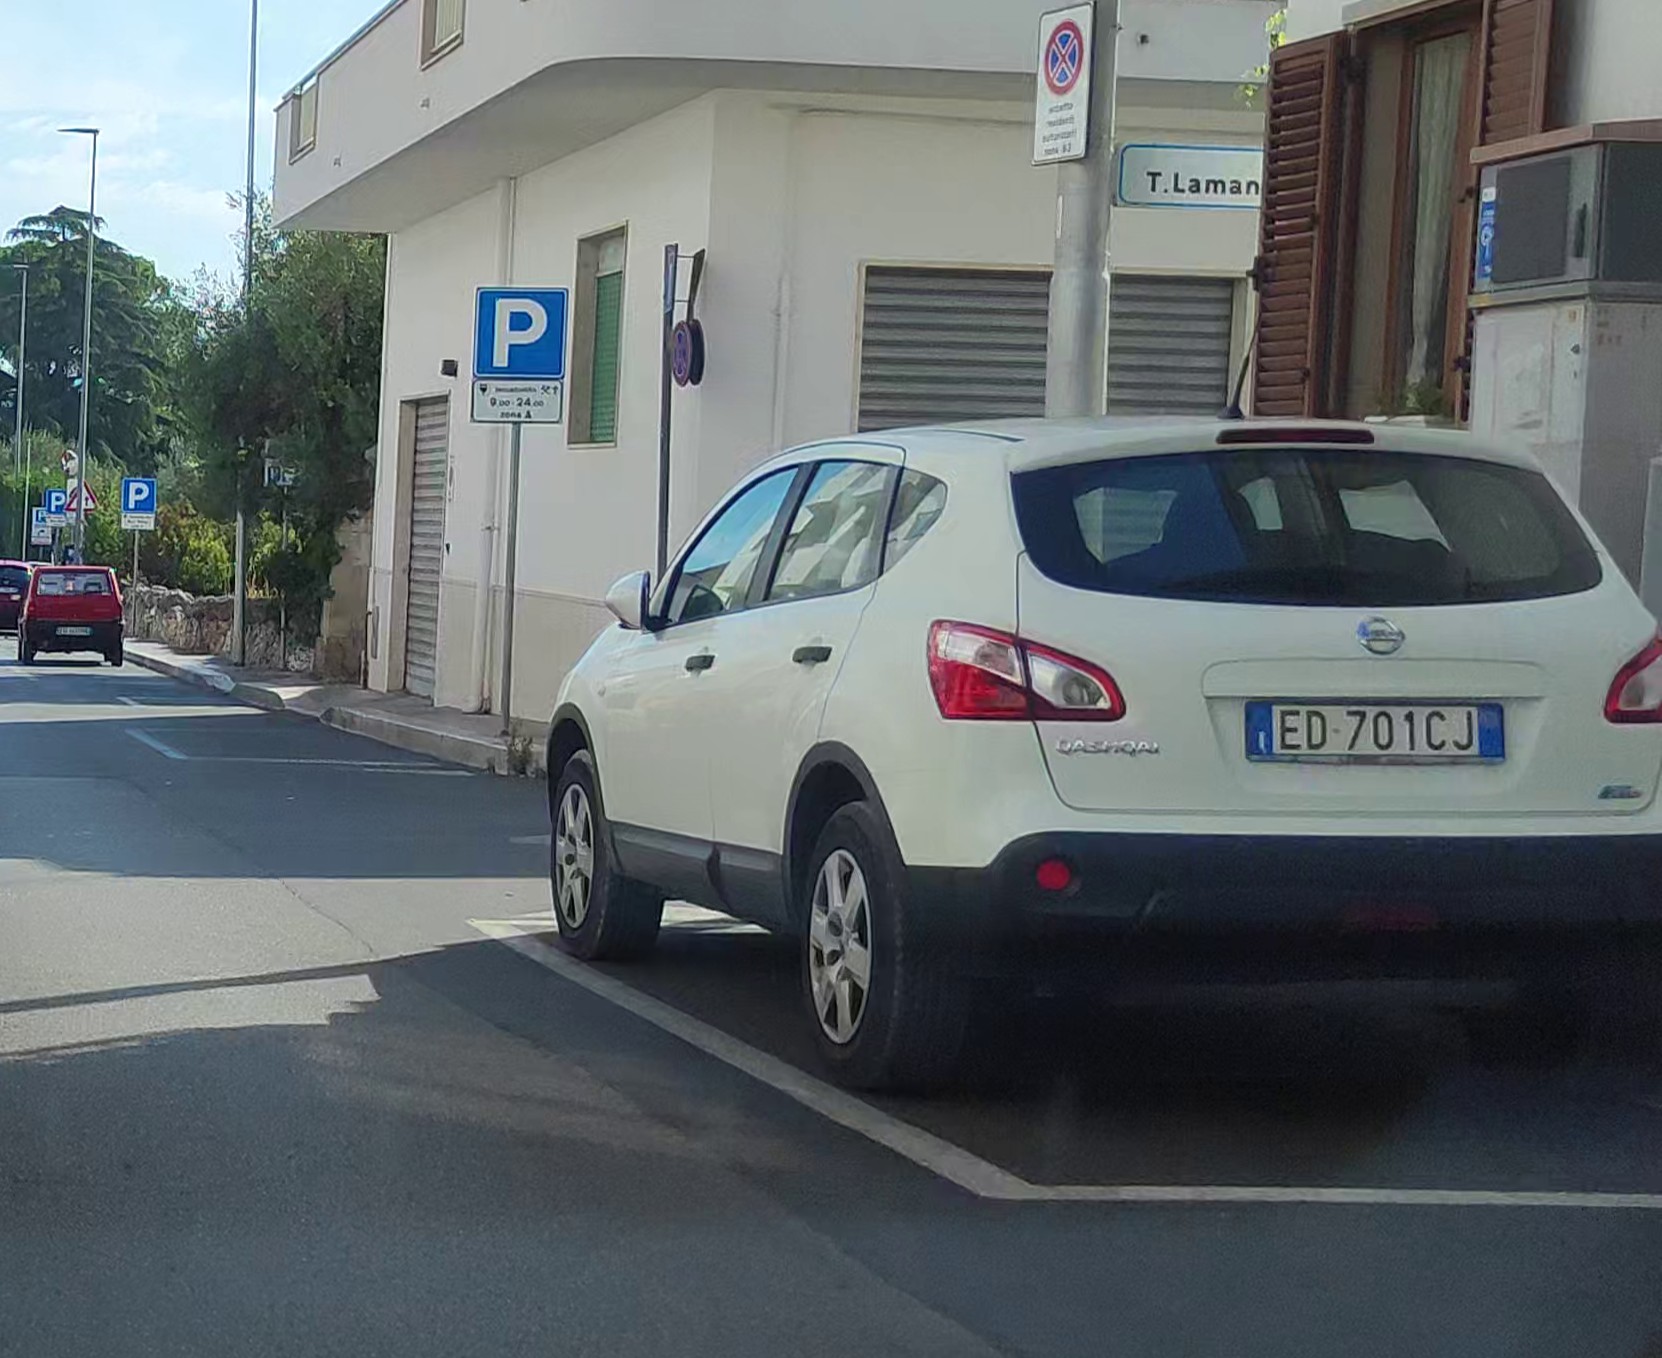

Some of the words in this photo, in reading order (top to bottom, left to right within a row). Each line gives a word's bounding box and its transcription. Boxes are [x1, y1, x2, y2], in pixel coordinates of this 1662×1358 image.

[492, 297, 548, 368] P
[525, 410, 532, 419] A
[51, 492, 66, 512] P
[128, 482, 150, 509] P
[1279, 709, 1327, 751] ED
[1346, 709, 1474, 751] 701CJ
